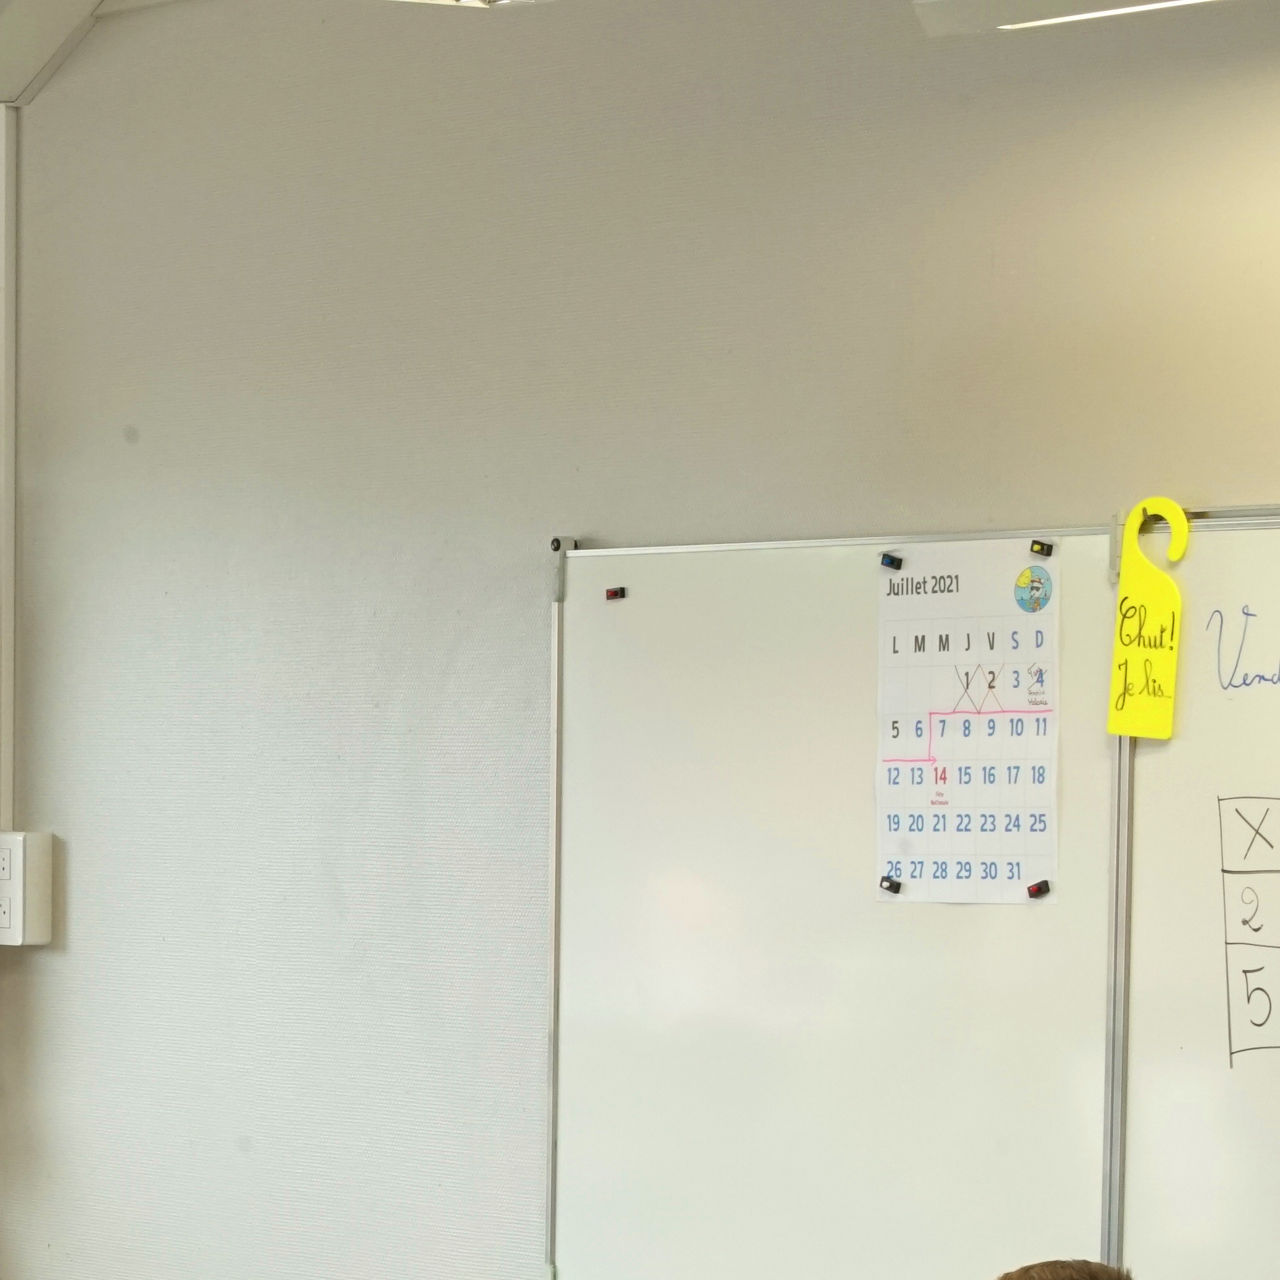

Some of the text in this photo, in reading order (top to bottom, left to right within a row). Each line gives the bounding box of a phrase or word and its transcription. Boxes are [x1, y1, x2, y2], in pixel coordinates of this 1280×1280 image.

[886, 574, 959, 596] Juillet 2021
[892, 629, 1044, 655] L M M J V S D
[987, 670, 996, 690] 2
[1012, 670, 1020, 689] 3
[1115, 659, 1135, 711] Je
[891, 717, 1047, 739] 5 6 7 8 9 10 11
[887, 765, 1046, 786] 12 13 14 15 16 17 18
[886, 813, 1047, 833] 19 20 21 22 23 24 25
[887, 860, 1021, 881] 26 27 28 29 30 31
[1241, 886, 1263, 932] 2
[1242, 966, 1272, 1027] 5
